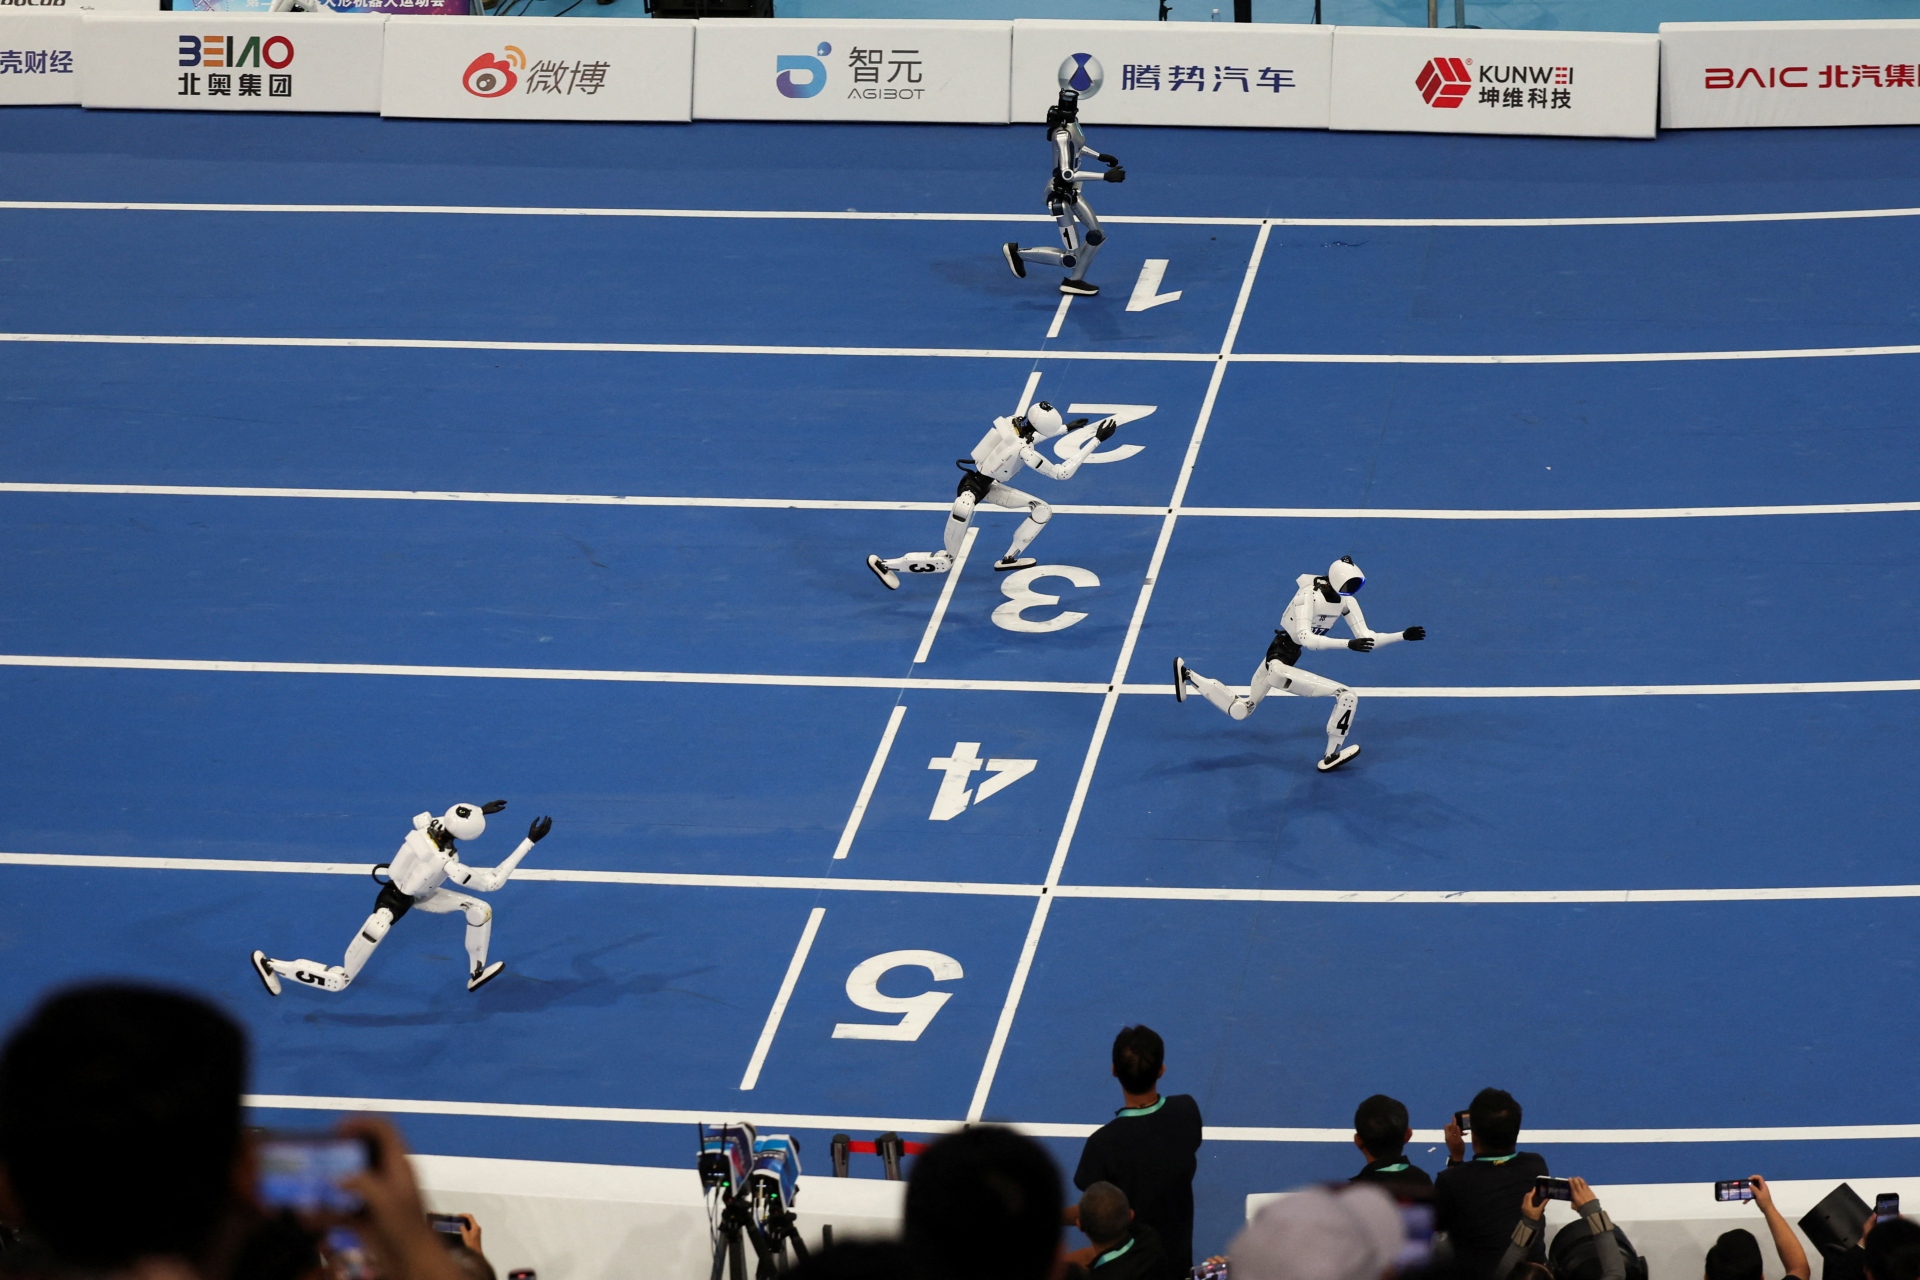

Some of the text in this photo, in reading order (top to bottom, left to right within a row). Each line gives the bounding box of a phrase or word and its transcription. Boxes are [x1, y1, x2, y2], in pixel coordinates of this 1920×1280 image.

[0, 49, 74, 75] 壳财经
[179, 35, 295, 69] BEIAO
[525, 59, 611, 96] 微博
[848, 47, 923, 84] 智元
[1479, 65, 1574, 85] KUNWEI
[1705, 64, 1920, 89] BAIC 北汽集
[178, 73, 293, 97] 北奥集团
[1122, 65, 1296, 93] 腾势汽车
[847, 88, 926, 100] AGIBOT
[1478, 87, 1572, 109] 坤维科技
[1063, 228, 1073, 249] 1
[1125, 258, 1183, 312] 1
[1053, 403, 1158, 464] 2
[909, 564, 936, 573] 3
[991, 564, 1101, 633] 3
[1336, 709, 1352, 735] 4
[928, 741, 1038, 821] 4
[295, 970, 325, 986] 5
[831, 949, 964, 1042] 5
